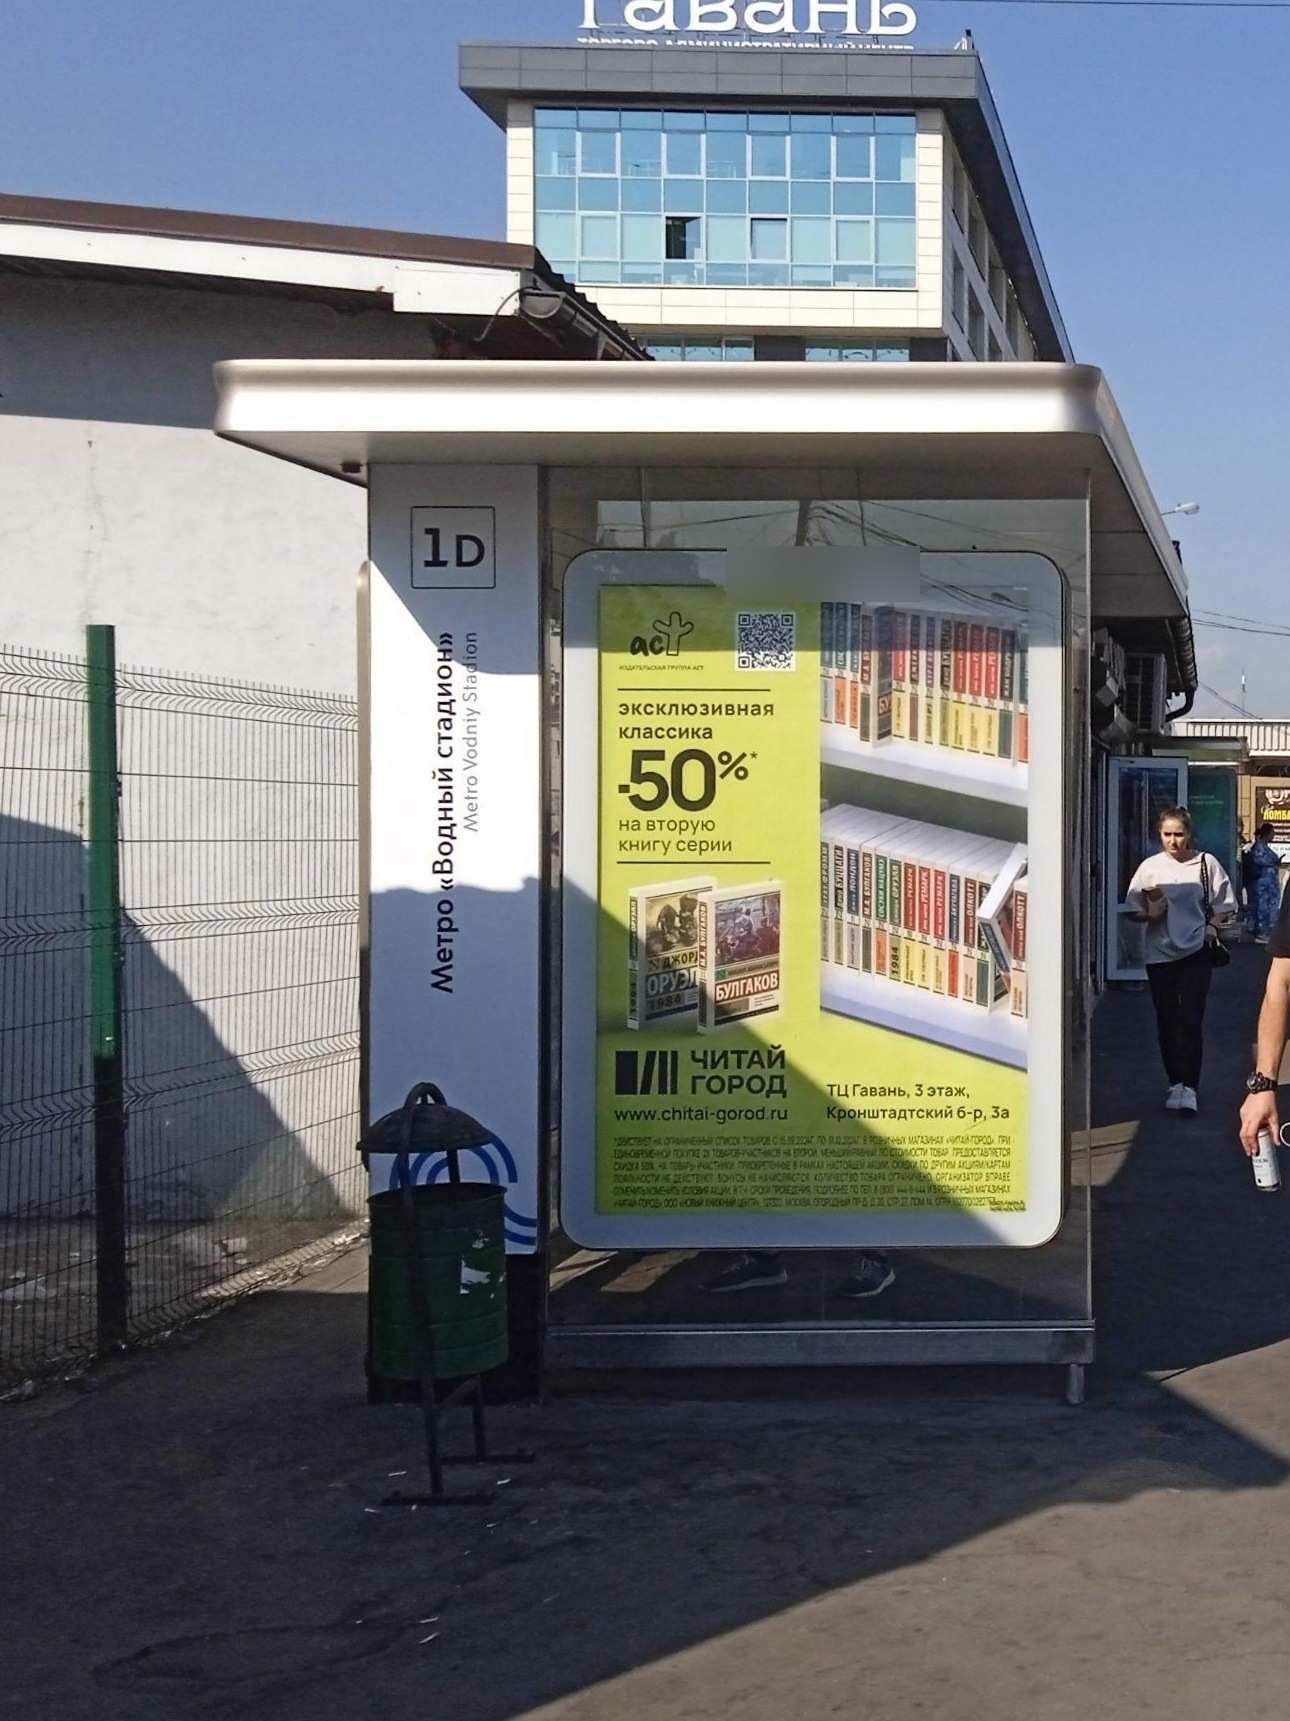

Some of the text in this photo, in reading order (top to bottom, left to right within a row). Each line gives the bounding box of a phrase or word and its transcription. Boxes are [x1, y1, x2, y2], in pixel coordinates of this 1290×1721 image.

[422, 527, 486, 569] 1D
[619, 703, 774, 716] эксклюзивная
[462, 631, 481, 833] Metro Vodniy Stadion
[619, 726, 713, 739] классика
[431, 632, 459, 994] Метро «Водный стадион»
[619, 819, 716, 835] на вторую
[619, 840, 732, 856] книгу серии
[849, 852, 857, 893] ЛОНДОН
[919, 870, 929, 902] РЕМАРК
[966, 882, 975, 917] ОЛКОТТ
[1016, 894, 1026, 929] ОЛКОТТ
[891, 946, 899, 976] 1984
[715, 972, 779, 1002] БУЛГАКОВ
[691, 1044, 786, 1070] ЧИТАЙ
[691, 1075, 787, 1098] ГОРОД
[827, 1084, 971, 1101] ТЦ Гавань, 3 этаж,
[614, 1106, 788, 1125] www.chitai-gorod.ru
[826, 1105, 1010, 1122] Кронштадтский б-р, 3а
